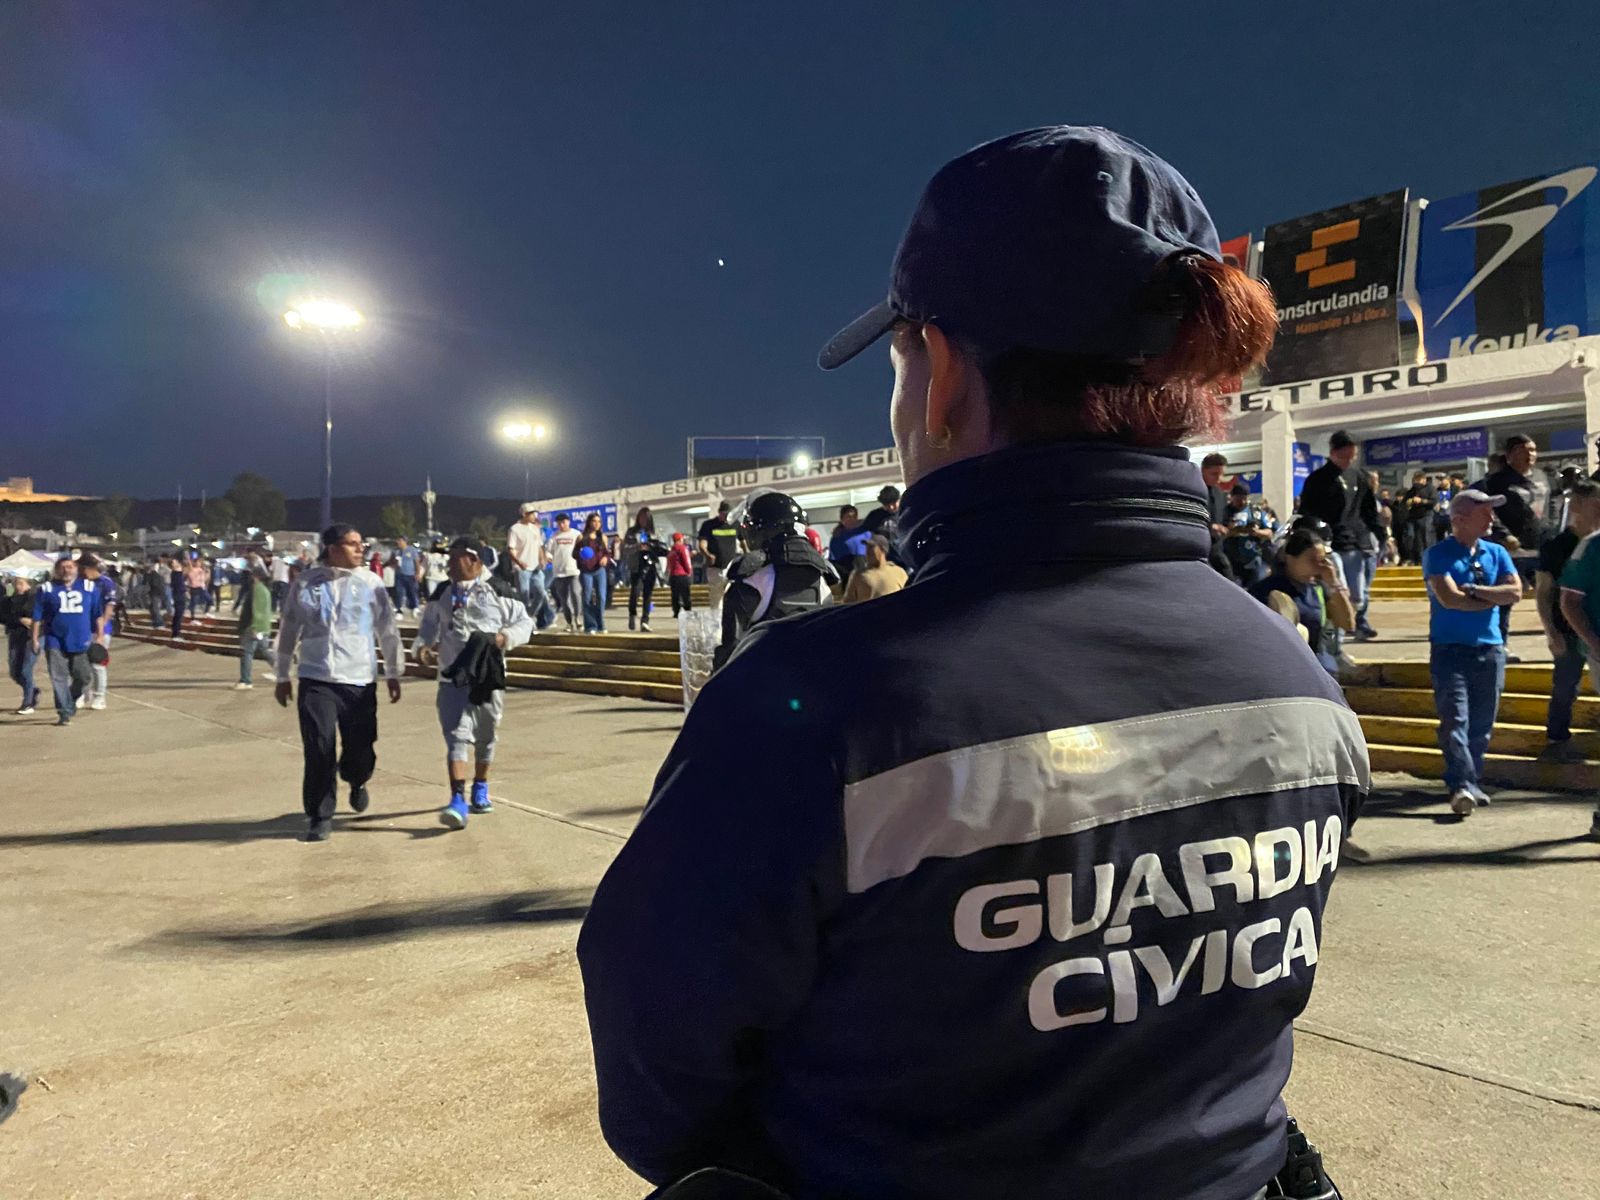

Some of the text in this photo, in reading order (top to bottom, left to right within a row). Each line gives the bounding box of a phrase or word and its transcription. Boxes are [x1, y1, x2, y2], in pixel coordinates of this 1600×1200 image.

[1278, 284, 1389, 321] onstrulandia
[772, 449, 899, 480] CORREGI
[58, 591, 83, 613] 12
[953, 815, 1342, 952] GUARDIA
[1028, 906, 1319, 1032] CÍVICA
